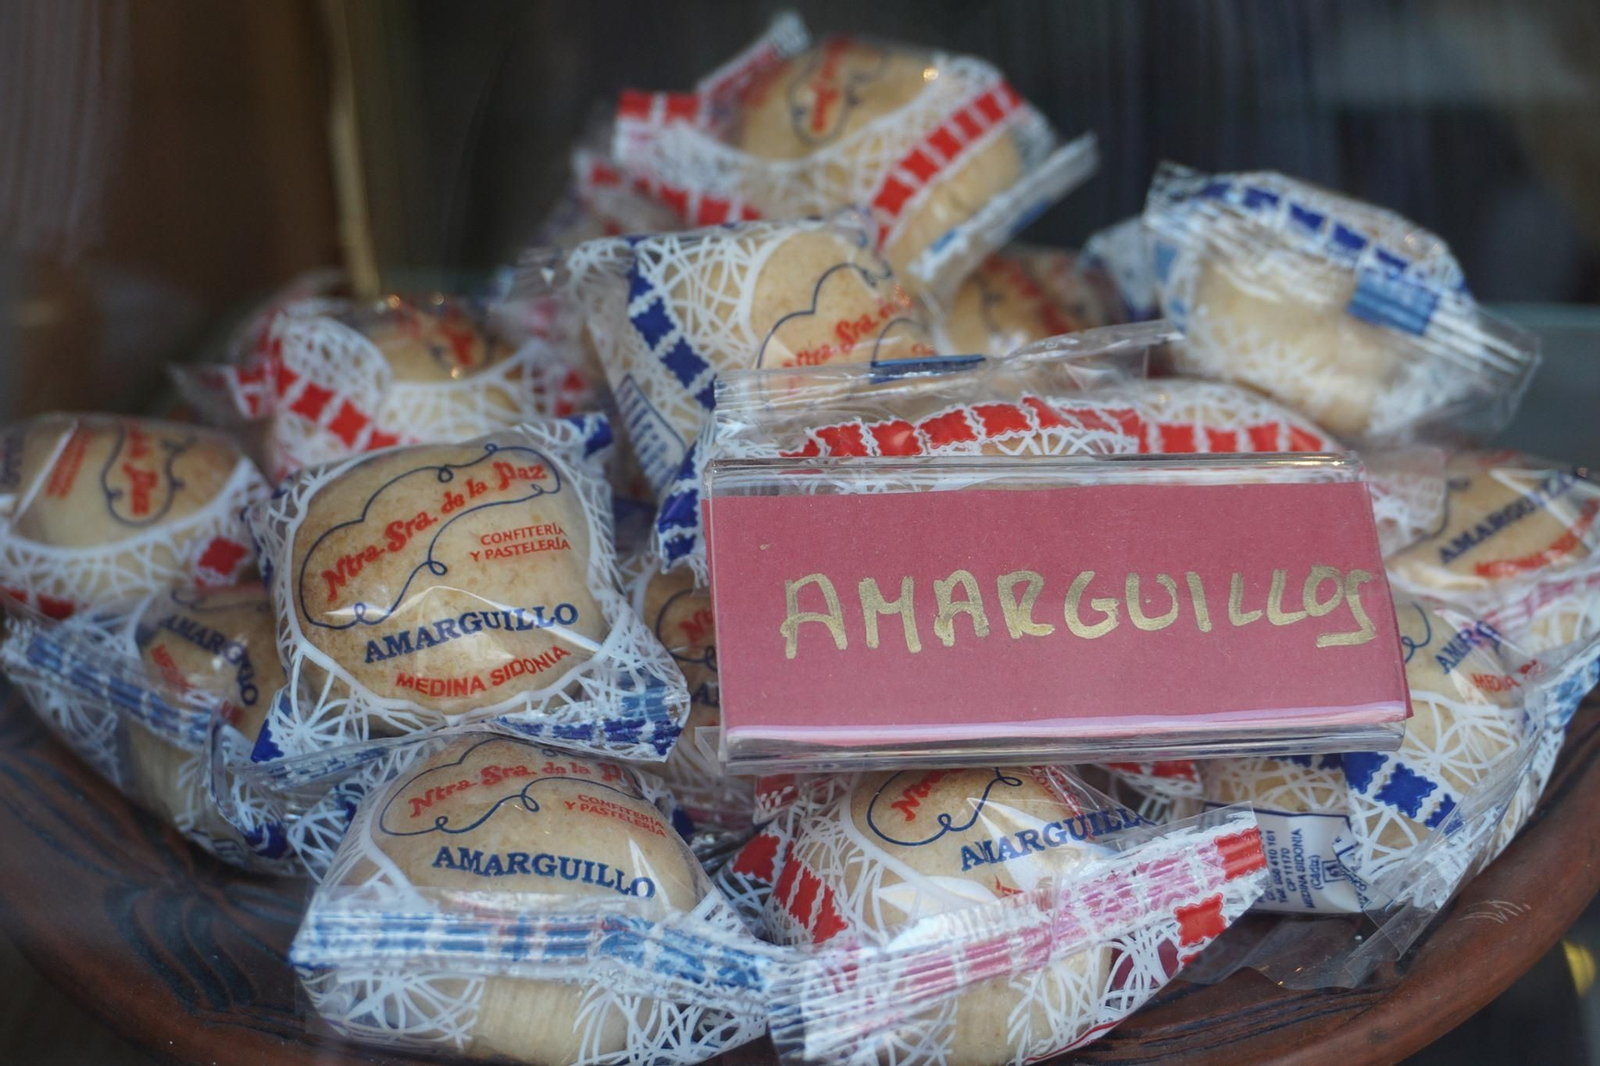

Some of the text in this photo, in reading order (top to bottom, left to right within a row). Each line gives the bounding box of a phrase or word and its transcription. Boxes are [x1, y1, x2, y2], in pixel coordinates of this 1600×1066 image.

[440, 491, 465, 514] de
[466, 478, 488, 498] la
[492, 461, 547, 491] Paz
[470, 551, 481, 563] Y
[364, 602, 579, 664] AMARGUILLO
[780, 567, 1377, 660] AMARGUILLOS
[395, 644, 571, 697] MEDINA SIDONIA
[541, 762, 567, 775] de
[568, 762, 592, 775] la
[564, 801, 576, 811] Y
[432, 846, 656, 899] AMARGUILLO
[1281, 847, 1297, 892] CP 11170
[1291, 828, 1317, 909] MEDINA SIDONIA
